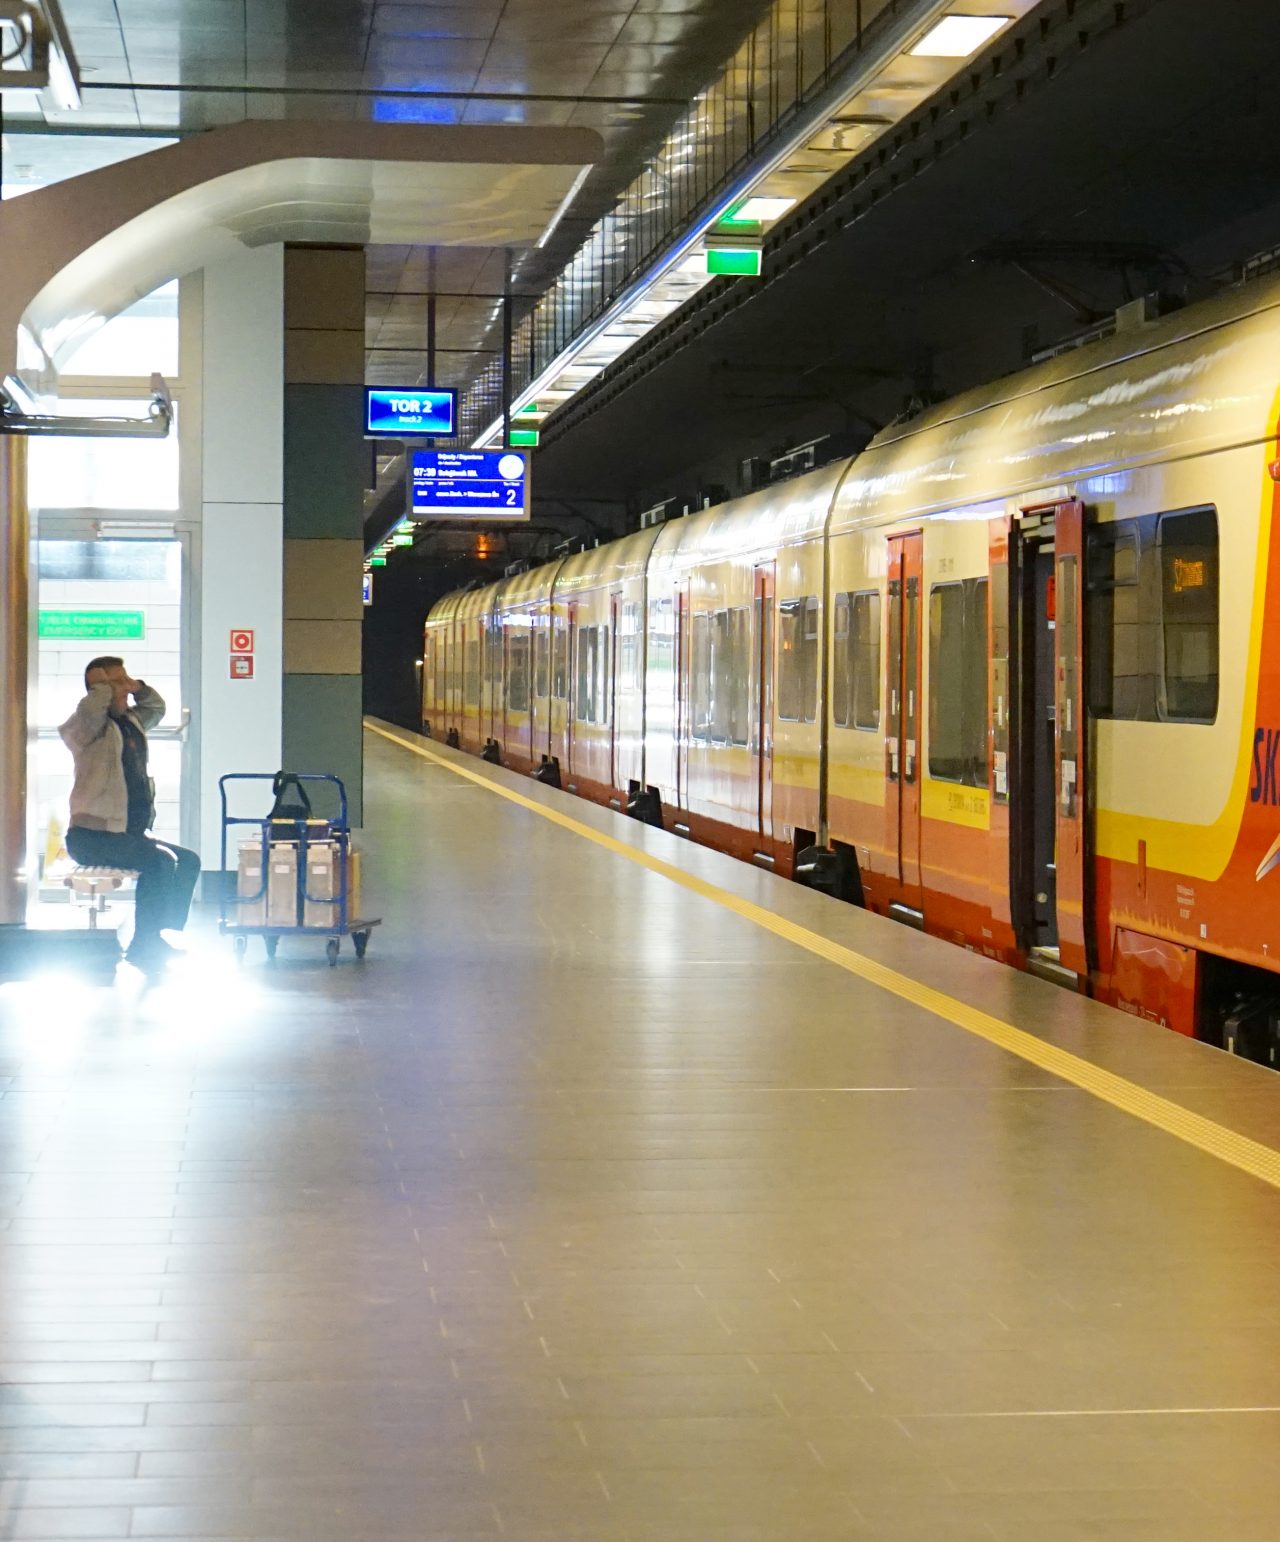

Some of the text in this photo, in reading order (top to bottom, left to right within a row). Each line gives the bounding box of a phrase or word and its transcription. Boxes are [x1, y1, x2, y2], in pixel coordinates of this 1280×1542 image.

[388, 399, 433, 413] TOR 2
[506, 489, 517, 506] 2
